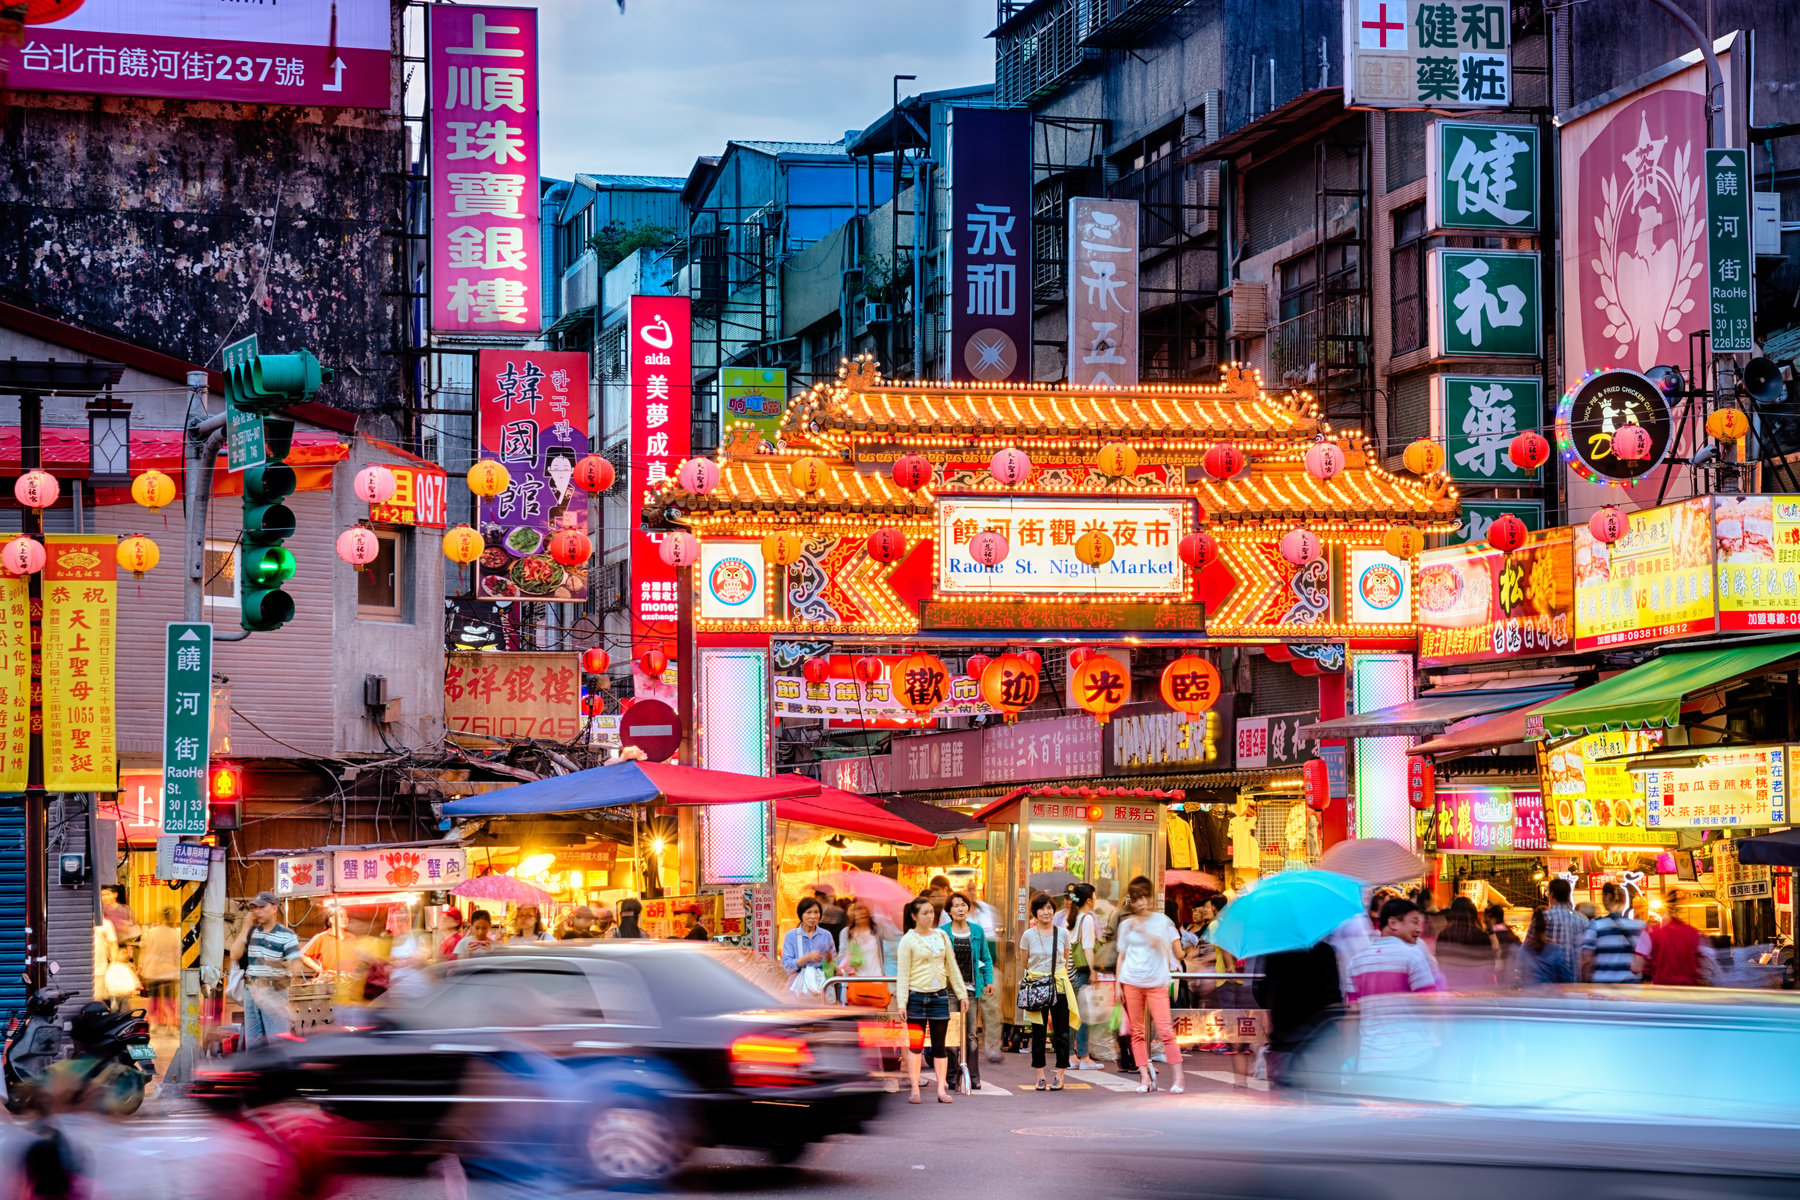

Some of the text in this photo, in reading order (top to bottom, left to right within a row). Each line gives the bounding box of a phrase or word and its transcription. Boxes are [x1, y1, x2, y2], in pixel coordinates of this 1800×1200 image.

[1415, 2, 1505, 49] 健和
[20, 41, 304, 88] 台北市饒河街237號
[1416, 56, 1505, 101] 藥粧
[445, 13, 528, 324] 上順珠寶銀樓
[1715, 172, 1741, 281] 饒河街
[967, 203, 1016, 316] 永和
[1713, 288, 1747, 298] RaoHe
[1713, 303, 1727, 314] St.
[1716, 319, 1748, 329] 30 33
[1714, 338, 1751, 348] 226 255
[645, 353, 670, 366] aida
[1604, 386, 1620, 394] FRIED
[1622, 386, 1645, 402] CHICKEN
[493, 360, 545, 521] 韓國館
[645, 374, 669, 544] 美夢成真
[1016, 559, 1037, 574] St.
[1110, 559, 1174, 574] Market
[51, 586, 108, 604] 恭祝
[1635, 589, 1647, 609] VS
[904, 669, 941, 705] 歡
[1002, 670, 1035, 705] 迎
[1084, 672, 1124, 703] 光
[1171, 671, 1211, 702] 臨
[175, 647, 201, 761] 饒河街
[1239, 728, 1267, 759] 各國名藥
[168, 767, 203, 778] RaoHe
[167, 783, 182, 795] St.
[1771, 751, 1784, 822] 實在老口味
[168, 800, 202, 811] 30 33
[1033, 804, 1156, 822] 媽祖廟口 服務台
[166, 820, 205, 831] 226 255
[1438, 799, 1473, 844] 松鶴
[755, 903, 763, 927] 自行車
[758, 929, 770, 961] 禁止進入
[1173, 1016, 1257, 1037] 徒步區
